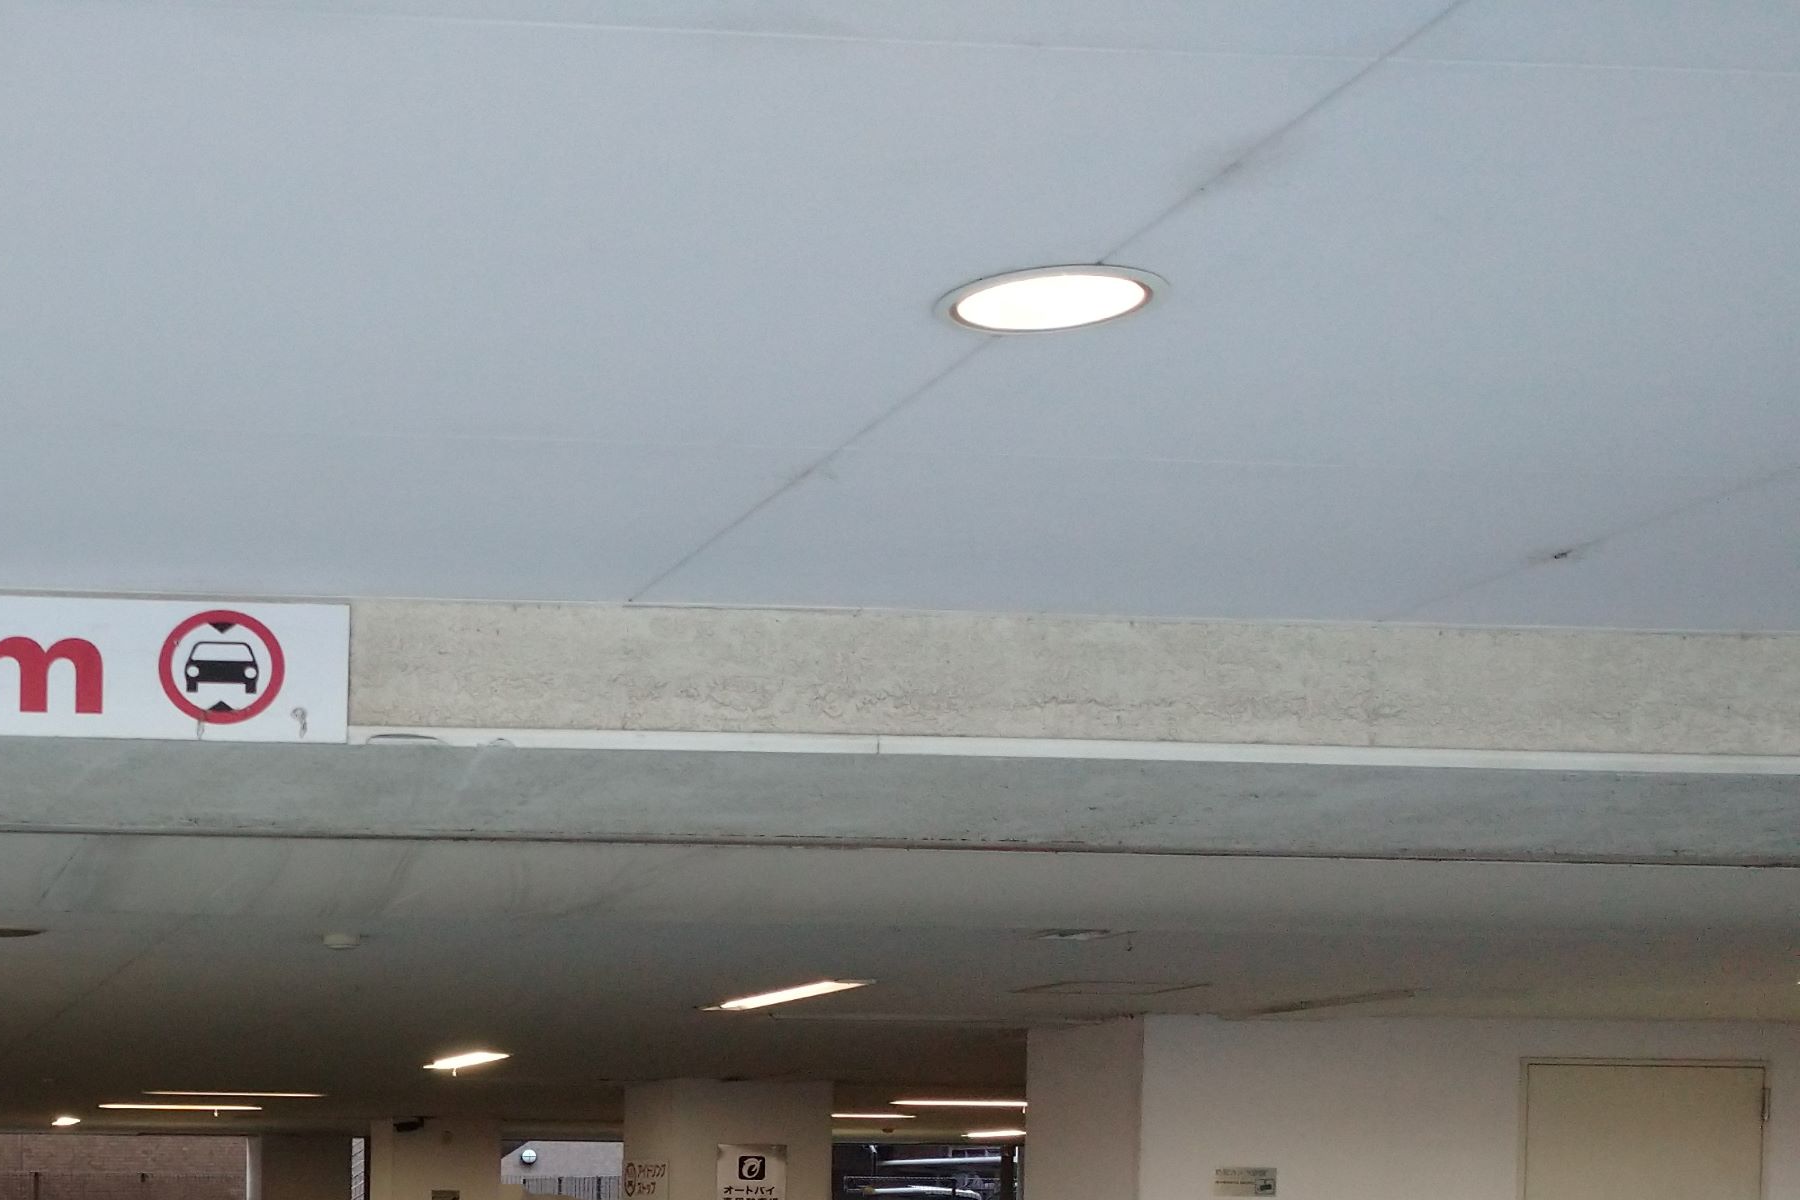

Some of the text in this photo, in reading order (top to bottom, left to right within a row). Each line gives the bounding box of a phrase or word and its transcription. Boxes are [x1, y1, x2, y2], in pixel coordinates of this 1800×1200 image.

[723, 1186, 776, 1195] オートバイ
